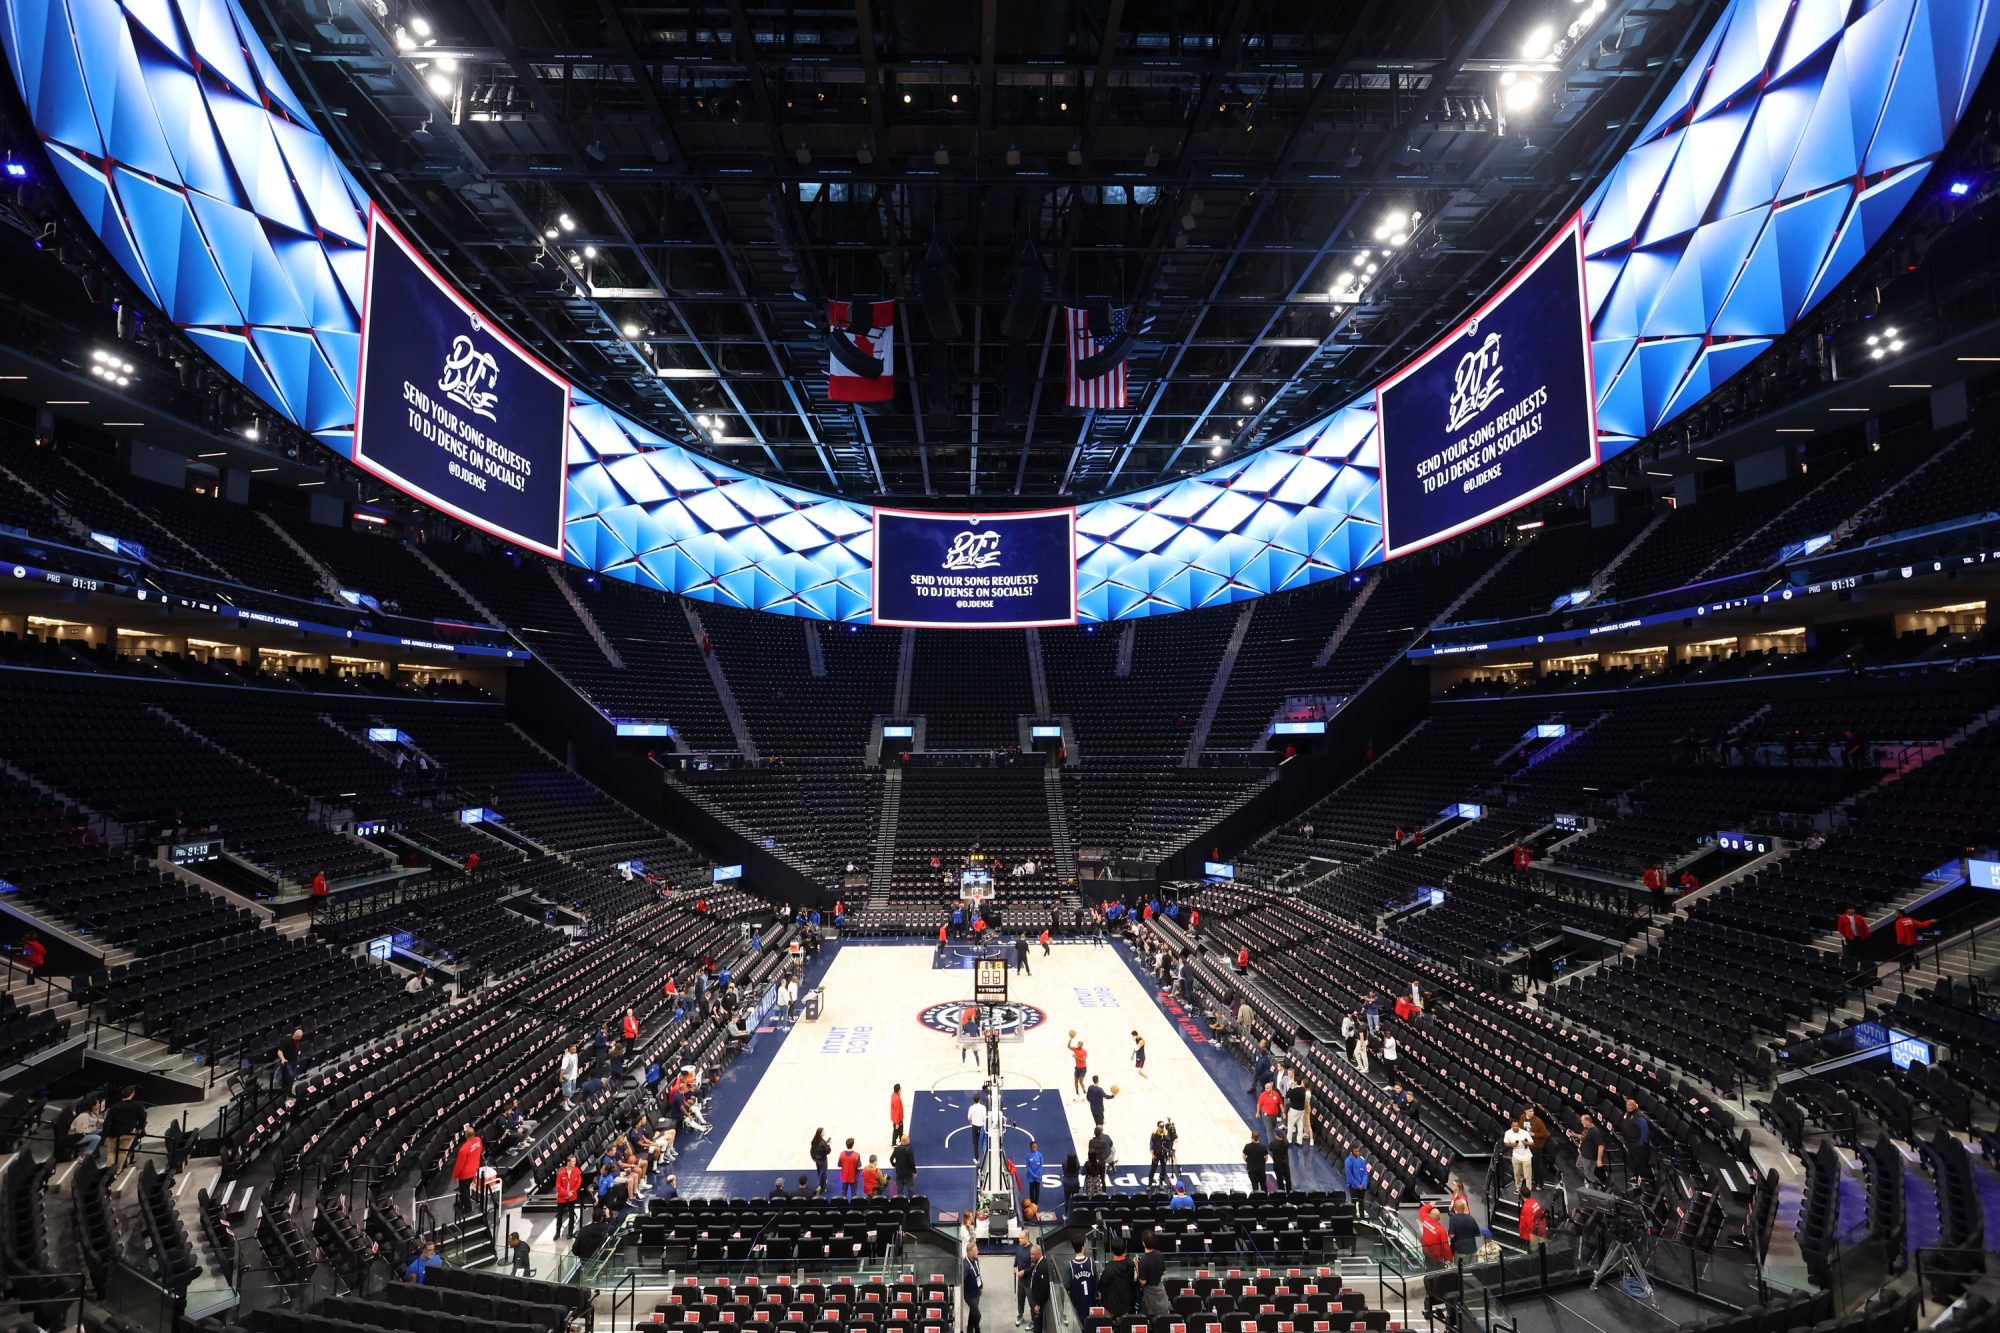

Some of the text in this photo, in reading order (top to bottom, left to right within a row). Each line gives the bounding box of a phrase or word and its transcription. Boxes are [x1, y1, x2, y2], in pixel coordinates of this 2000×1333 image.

[403, 381, 531, 476] SEND YOUR SONG REQUESTS
[1416, 385, 1548, 478] SEND YOUR SONG REQUESTS
[408, 408, 525, 493] TO DJ DENSE ON SOCIALS!
[1423, 413, 1543, 494] TO DJ DENSE ON SOCIALS!
[448, 461, 487, 492] @DJDENSE
[1463, 463, 1502, 493] @DJDENSE
[1934, 562, 1941, 571] 0
[1980, 553, 1986, 562] 7
[46, 573, 97, 591] PRG 81:13
[910, 574, 1039, 586] SEND YOUR SONG REQUESTS
[1808, 578, 1856, 594] PRG 81:13
[916, 586, 1033, 598] TO DJ DENSE ON SOCIALS!
[956, 600, 995, 609] @DJDENSE
[239, 610, 299, 628] LOS ANGELES CLIPPERS
[1598, 623, 1618, 633] ANGELES
[1618, 620, 1641, 629] CLIPPERS
[411, 640, 432, 649] ANGELES
[432, 643, 454, 651] CLIPPERS
[1466, 643, 1488, 652] CLIPPERS
[1732, 840, 1764, 853] 0 0
[820, 1026, 849, 1053] INTUIT
[1892, 1035, 1926, 1058] INTUIT
[1080, 1280, 1089, 1296] 1
